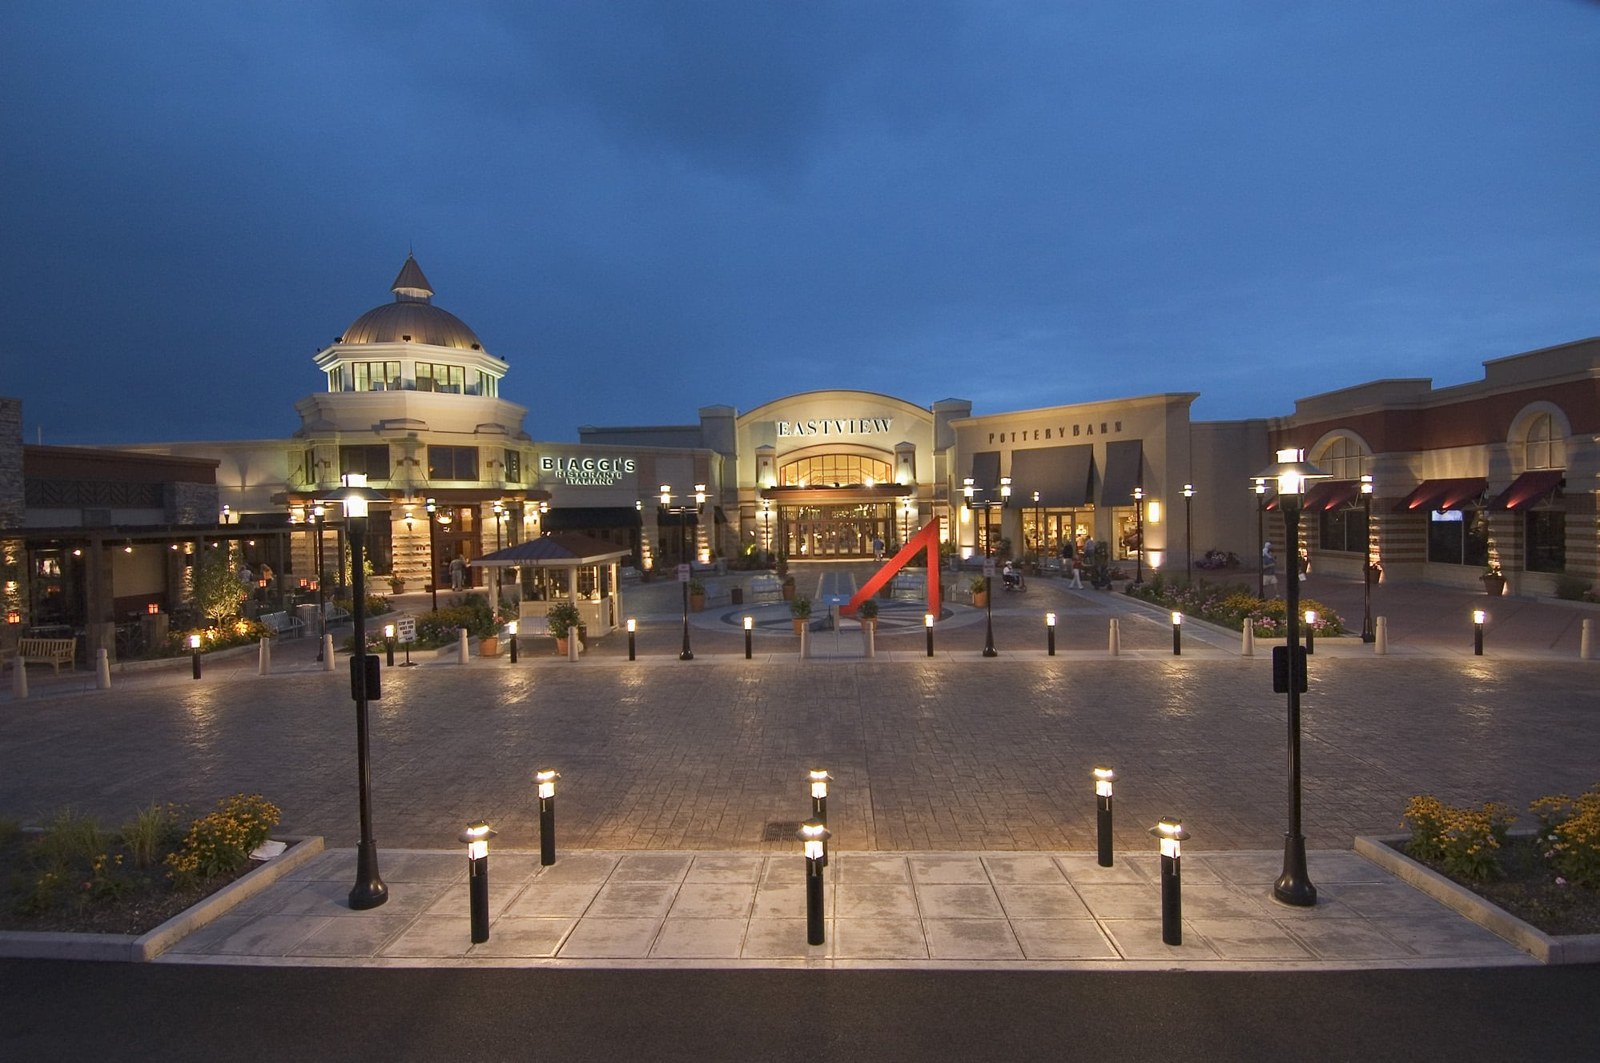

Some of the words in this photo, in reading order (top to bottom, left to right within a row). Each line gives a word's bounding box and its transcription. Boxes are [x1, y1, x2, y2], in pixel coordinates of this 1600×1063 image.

[778, 418, 893, 437] EASTVIEW
[541, 457, 635, 473] BIAGGI'S
[565, 478, 613, 486] ITALIANO
